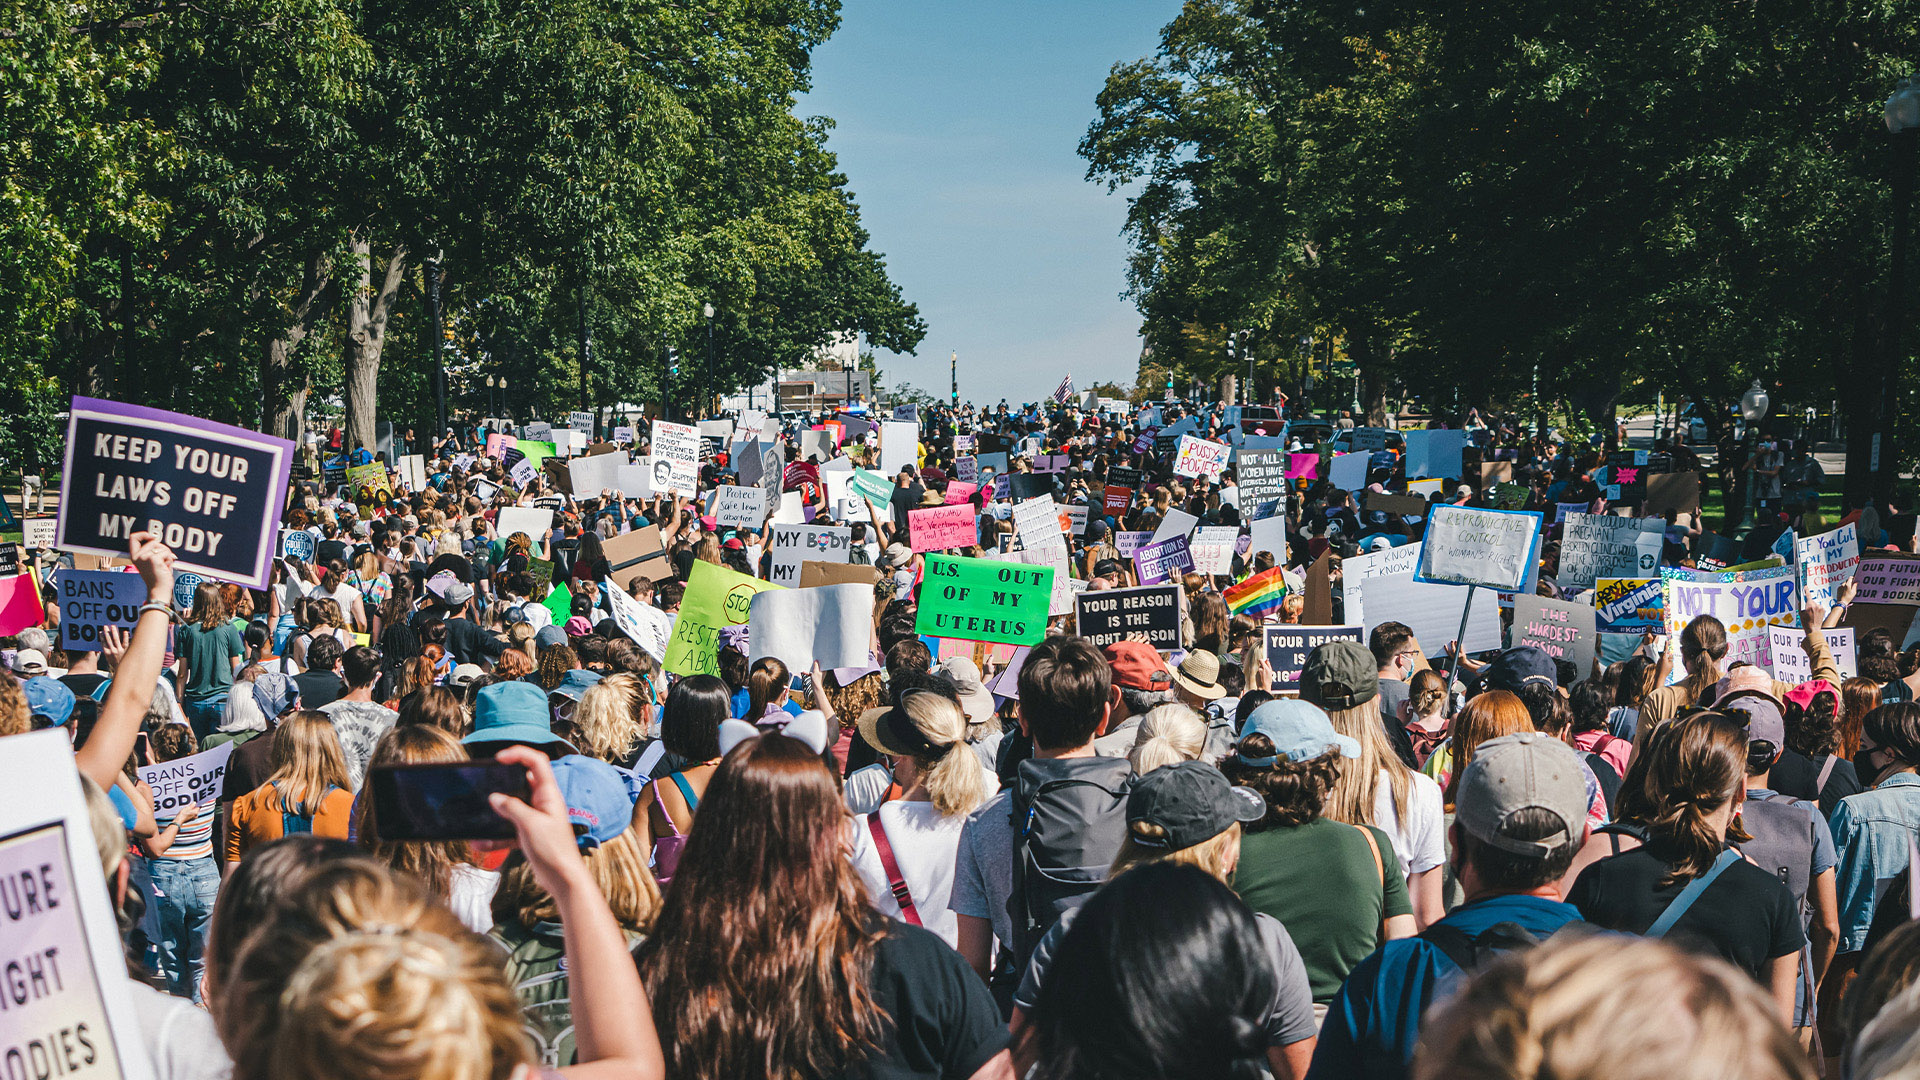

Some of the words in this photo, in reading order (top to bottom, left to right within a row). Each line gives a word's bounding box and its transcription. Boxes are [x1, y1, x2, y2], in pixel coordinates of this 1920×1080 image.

[572, 412, 592, 420] Mind
[658, 422, 692, 434] ABORTION
[656, 442, 694, 454] GOVERNED
[1188, 442, 1220, 460] PUSSY
[95, 432, 162, 464] KEEP
[174, 444, 248, 483] YOUR
[666, 452, 696, 462] REASON
[1240, 454, 1258, 466] NOT
[1262, 454, 1280, 465] ALL
[1180, 456, 1220, 477] POWER
[1238, 467, 1264, 478] WOMEN
[1266, 466, 1284, 477] HAVE
[672, 472, 697, 484] SUPPORT
[1268, 477, 1284, 486] AND
[96, 472, 172, 506] LAWS
[183, 486, 238, 519] OFF
[726, 487, 756, 499] Protect
[1240, 488, 1254, 498] NOT
[1254, 486, 1286, 495] EVERYONE
[724, 514, 752, 522] abortion
[1446, 512, 1523, 532] REPRODUCTIVE
[1564, 511, 1576, 524] IF
[1578, 513, 1596, 526] MEN
[1600, 514, 1625, 530] COULD
[1627, 518, 1644, 530] GET
[99, 512, 136, 540] MY
[148, 518, 224, 557] BODY
[290, 532, 308, 542] KEEP
[776, 531, 801, 548] MY
[806, 531, 851, 552] BODY
[1458, 530, 1504, 546] CONTROL
[1570, 525, 1616, 542] PREGNANT
[1140, 542, 1176, 562] ABORTION
[1176, 538, 1184, 550] IS
[1562, 540, 1590, 552] ABORTION
[1800, 538, 1812, 554] IF
[1816, 536, 1835, 550] You
[1368, 554, 1376, 568] I
[1384, 545, 1415, 563] KNOW
[1448, 546, 1484, 560] WOMAN'S
[1488, 554, 1516, 567] RIGHT
[1561, 552, 1572, 563] BE
[1574, 553, 1587, 565] LIKE
[1826, 547, 1843, 562] MY
[773, 564, 796, 580] MY
[1143, 551, 1189, 578] FREEDOM
[1582, 564, 1592, 576] ON
[1862, 564, 1885, 572] OUR
[179, 574, 203, 585] KEEP
[932, 561, 960, 578] U.S.
[998, 568, 1044, 586] OUT
[1574, 573, 1596, 584] CORN
[1862, 576, 1887, 586] OUR
[64, 580, 114, 600] BANS
[943, 586, 970, 601] OF
[990, 590, 1022, 608] MY
[1856, 589, 1878, 598] OUR
[1082, 599, 1118, 614] YOUR
[1124, 594, 1173, 610] REASON
[1596, 582, 1662, 624] Virginia
[1677, 586, 1722, 617] NOT
[1730, 580, 1794, 618] YOUR
[67, 602, 104, 620] OFF
[106, 604, 140, 622] OU
[1540, 608, 1569, 622] THE
[1636, 608, 1664, 622] VOT
[936, 614, 1026, 636] UTERUS
[1108, 616, 1120, 628] IS
[1125, 613, 1150, 626] THE
[1528, 622, 1579, 643] HARDEST
[1270, 634, 1303, 648] YOUR
[1773, 634, 1792, 648] OUR
[1292, 653, 1306, 665] IS
[1779, 652, 1798, 667] OUR
[1272, 670, 1300, 682] RIG
[1778, 670, 1794, 684] OUR
[146, 763, 195, 784] BANS
[151, 780, 184, 798] OFF
[188, 766, 224, 790] OUR
[154, 782, 216, 812] BODIES
[568, 808, 599, 826] BANKS
[0, 862, 60, 921] URE
[0, 946, 64, 1011] IGHT
[0, 1022, 96, 1080] ODIES
